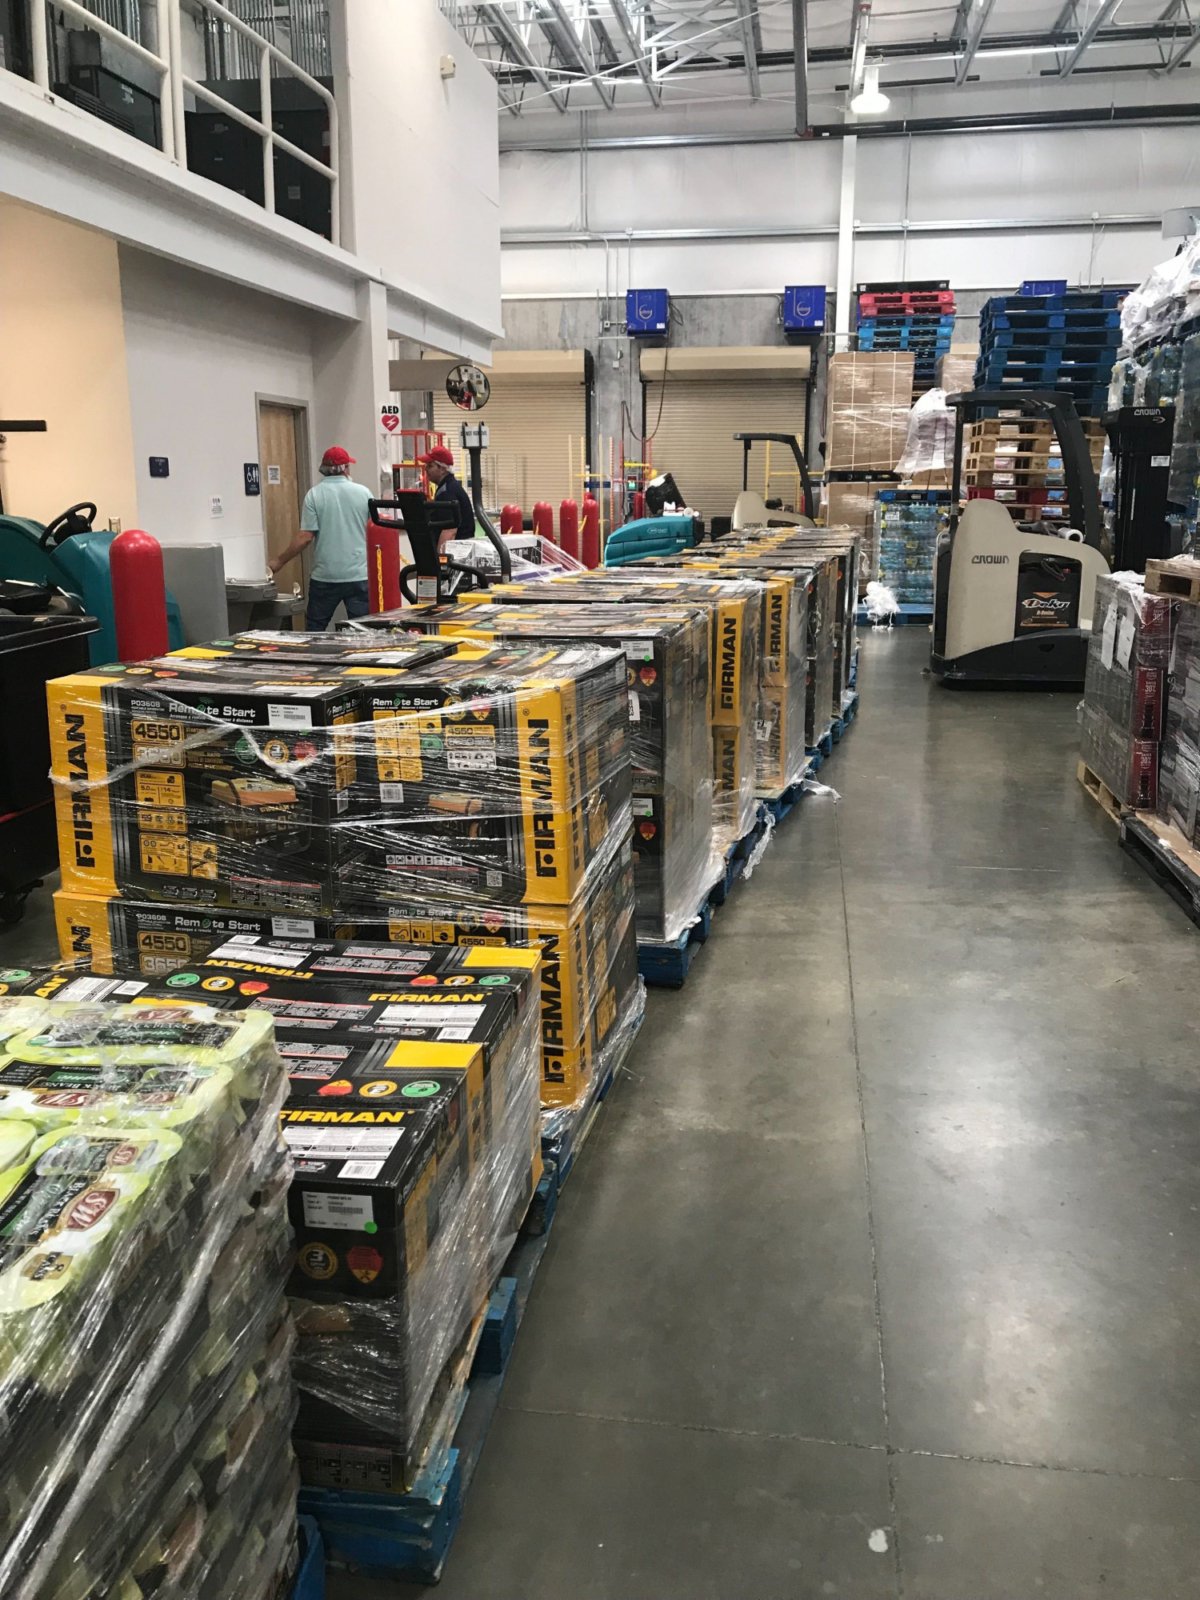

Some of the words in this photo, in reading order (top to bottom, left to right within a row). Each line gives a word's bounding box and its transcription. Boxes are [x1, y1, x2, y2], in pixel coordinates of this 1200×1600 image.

[381, 405, 399, 414] AED
[971, 555, 1009, 564] CROWN
[770, 595, 783, 673] FIRMAN
[721, 618, 736, 709] FIRMAN
[373, 698, 412, 707] Remote
[414, 698, 439, 706] Start
[223, 706, 256, 717] Start
[135, 723, 180, 740] 4550
[65, 714, 96, 868] FIRMAN
[528, 719, 558, 878] FIRMAN
[174, 917, 224, 929] Remote
[228, 920, 261, 931] Start
[141, 935, 187, 951] 4550
[461, 938, 485, 946] 4550
[204, 959, 314, 979] FIRMAN
[368, 993, 485, 1003] FIRMAN
[538, 934, 565, 1084] FIRMAN
